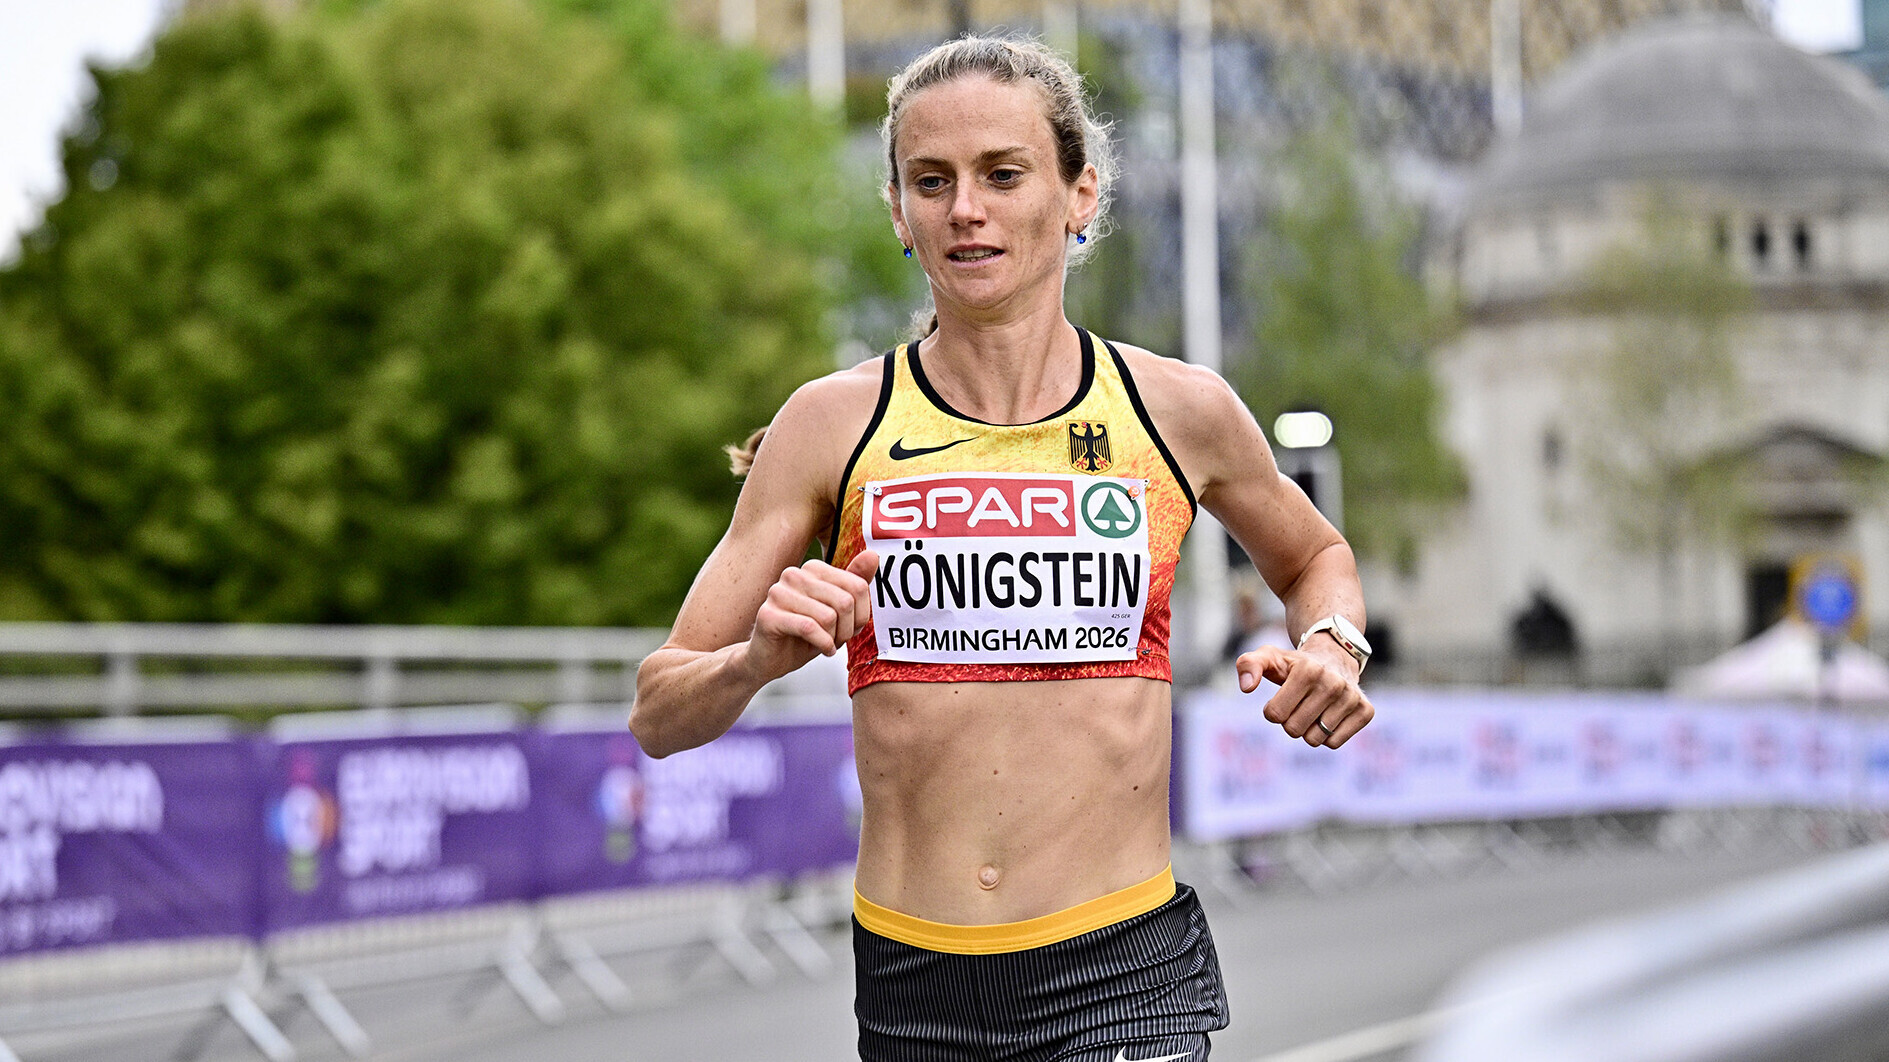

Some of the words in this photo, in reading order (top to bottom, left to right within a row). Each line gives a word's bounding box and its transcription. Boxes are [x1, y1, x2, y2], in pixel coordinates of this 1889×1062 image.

[878, 486, 1069, 531] SPAR
[875, 540, 1141, 609] KÖNIGSTEIN
[888, 627, 1068, 651] BIRMINGHAM
[1075, 626, 1130, 648] 2026
